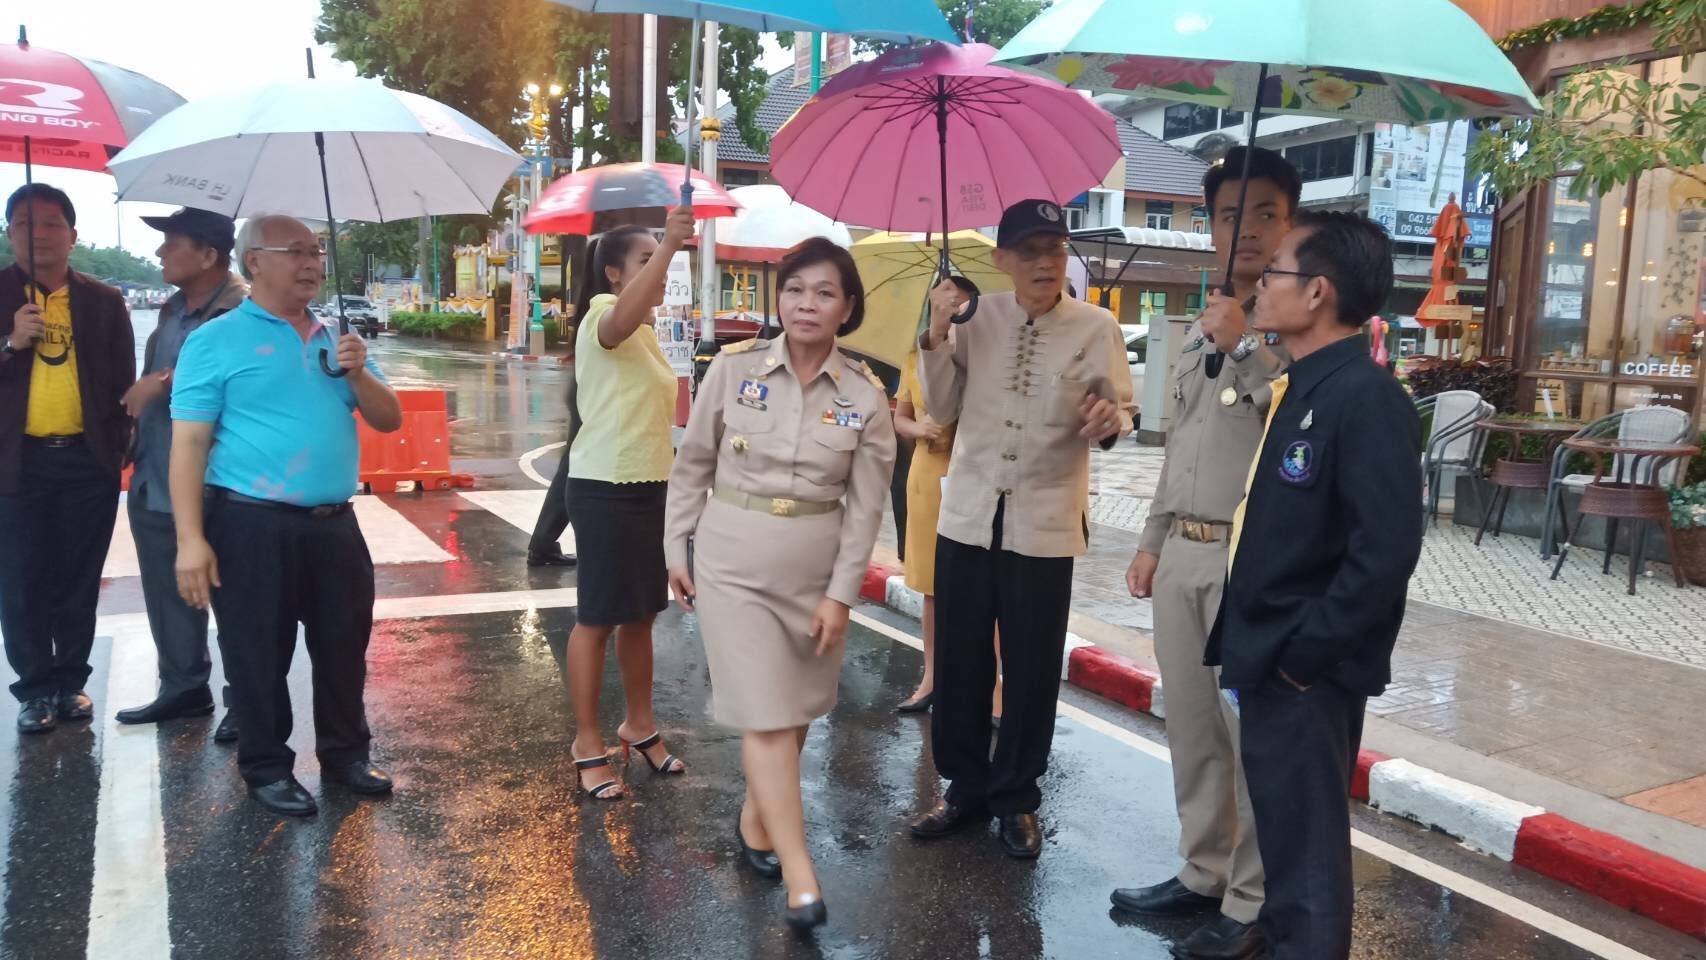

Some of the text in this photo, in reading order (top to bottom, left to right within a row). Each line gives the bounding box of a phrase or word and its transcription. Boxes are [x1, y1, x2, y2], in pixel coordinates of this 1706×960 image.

[43, 117, 92, 129] BOY
[1408, 213, 1425, 224] 042
[1401, 224, 1413, 234] 09
[1624, 361, 1693, 378] COFFEE
